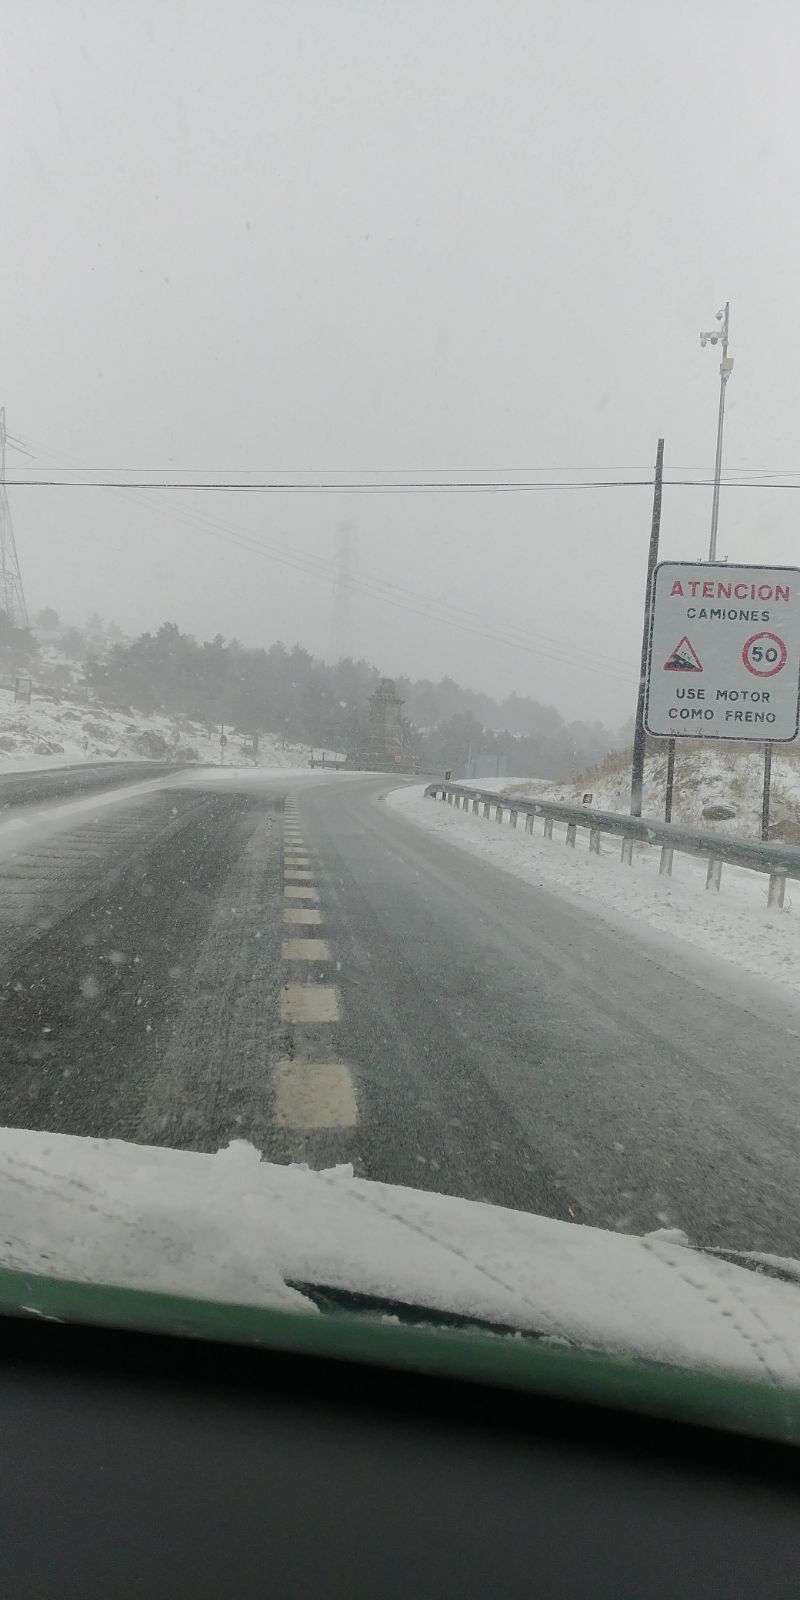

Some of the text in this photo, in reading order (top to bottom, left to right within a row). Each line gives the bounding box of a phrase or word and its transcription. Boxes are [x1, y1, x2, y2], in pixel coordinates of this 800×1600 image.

[670, 581, 790, 601] ATENCION
[686, 608, 770, 622] CAMIONES
[751, 646, 778, 663] 50
[676, 688, 771, 703] USE MOTOR
[668, 708, 776, 723] COMO FRENO
